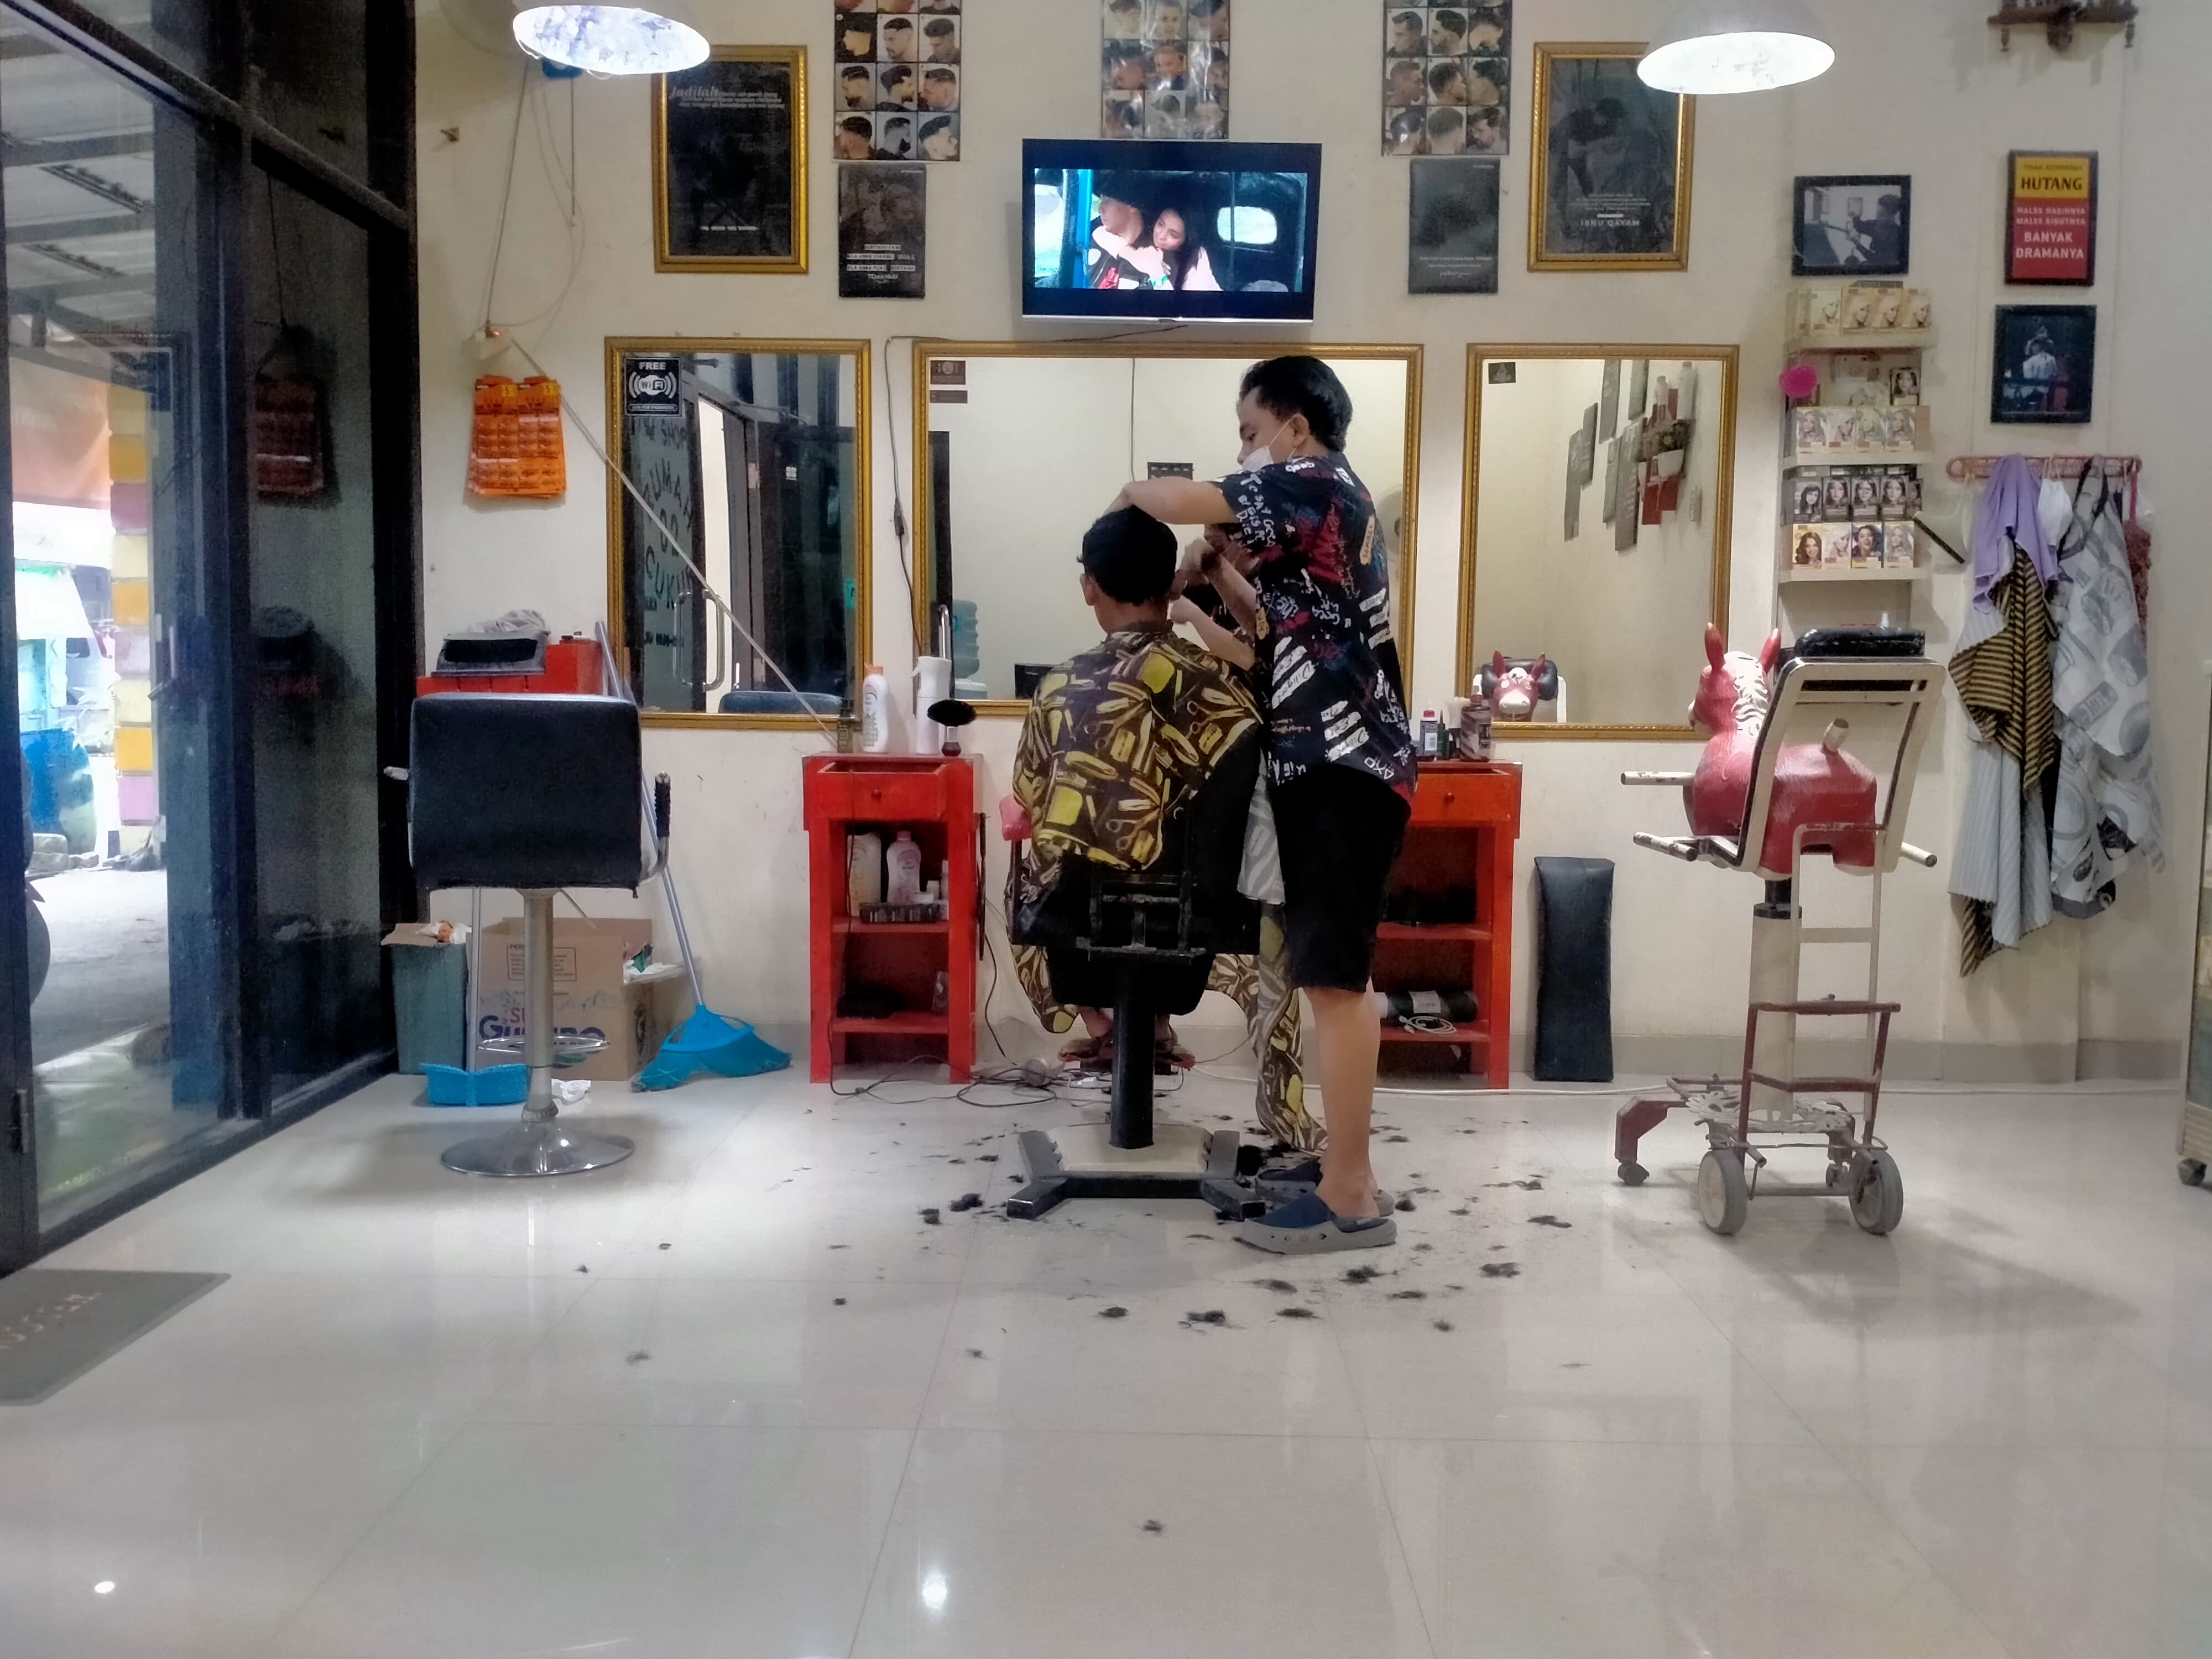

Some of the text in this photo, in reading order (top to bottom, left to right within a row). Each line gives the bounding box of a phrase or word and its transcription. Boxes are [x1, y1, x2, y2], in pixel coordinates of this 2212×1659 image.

[2021, 177, 2083, 190] HUTANG
[2024, 232, 2073, 242] BANYAK
[2016, 247, 2084, 259] DRAMANYA
[639, 361, 666, 371] FREE
